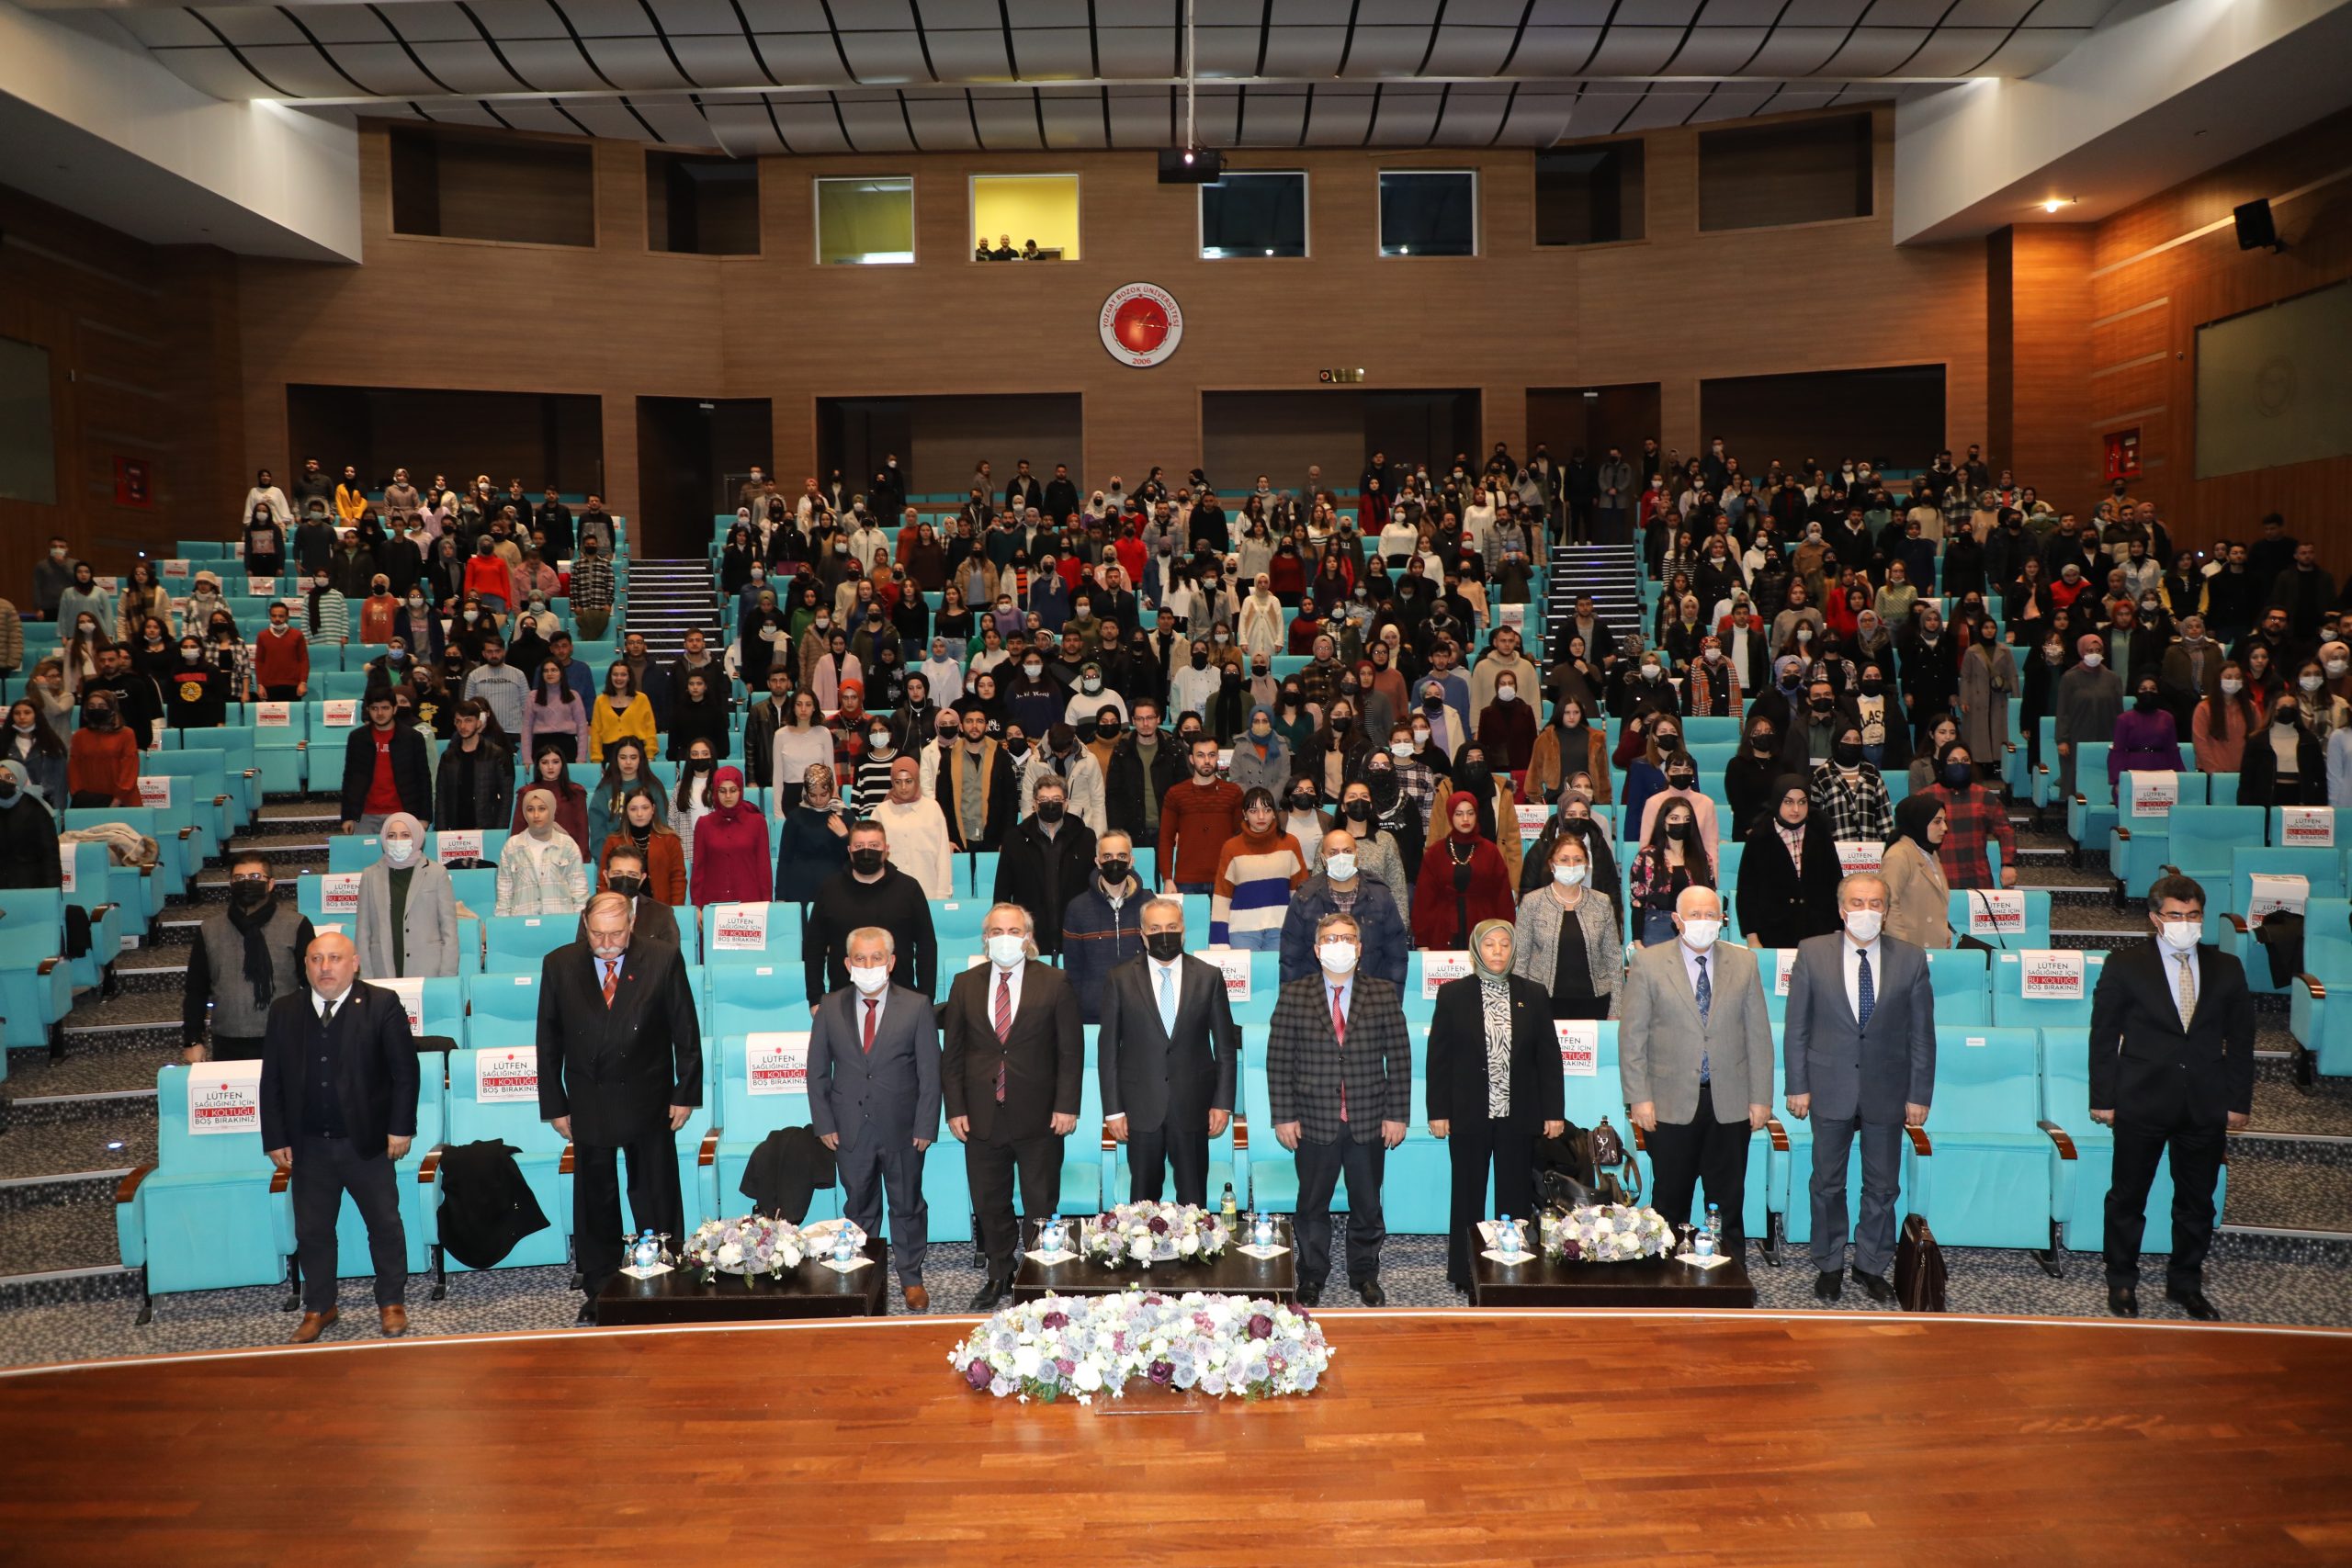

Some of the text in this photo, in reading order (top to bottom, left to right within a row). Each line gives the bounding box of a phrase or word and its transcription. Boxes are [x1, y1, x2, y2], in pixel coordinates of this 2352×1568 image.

[1102, 299, 1116, 329] YOZGAT
[1116, 287, 1141, 300] BOZOK
[763, 1055, 795, 1063] LÜTFEN
[493, 1062, 527, 1070] LÜTFEN
[768, 1070, 806, 1078] KOLTUĞU
[499, 1077, 537, 1086] KOLTUĞU
[207, 1091, 243, 1100] LÜTFEN
[239, 1100, 254, 1108] İÇİN
[212, 1107, 254, 1116] KOLTUĞU
[195, 1117, 211, 1125] BOŞ
